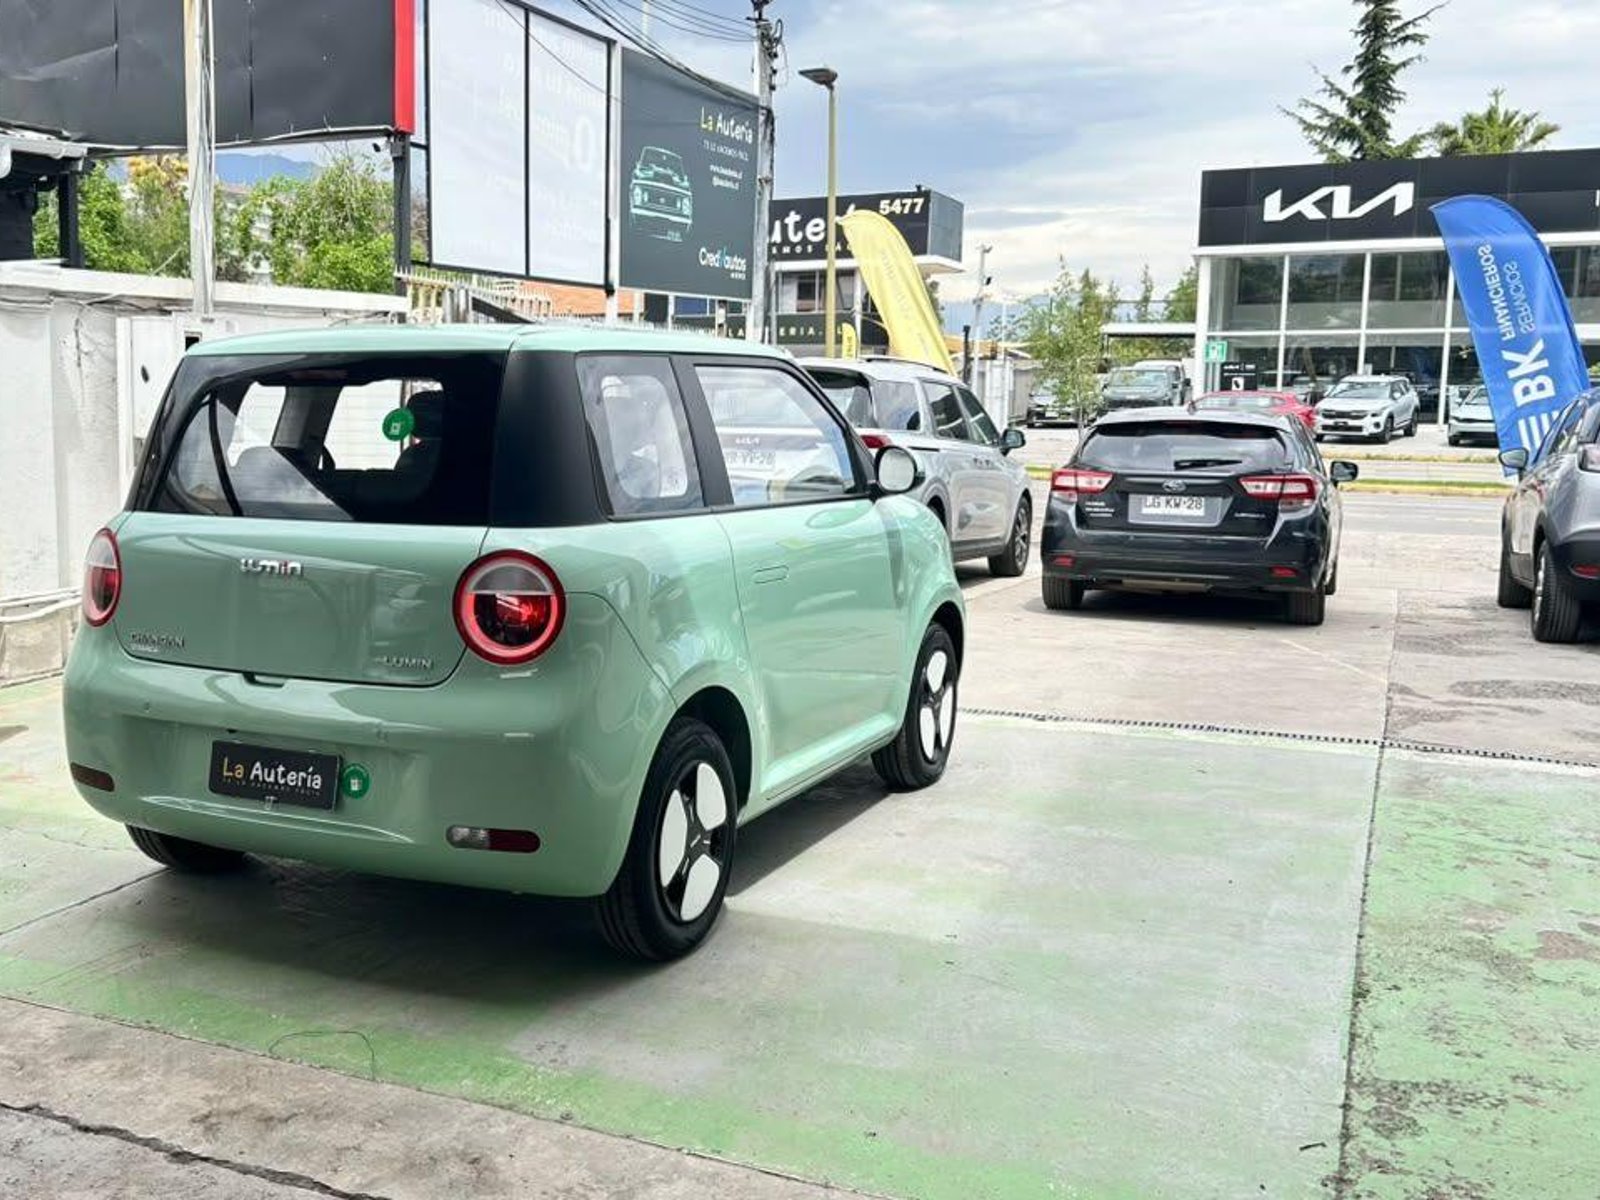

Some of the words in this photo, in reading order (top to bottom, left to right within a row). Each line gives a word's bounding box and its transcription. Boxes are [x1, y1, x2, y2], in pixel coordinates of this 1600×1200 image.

[878, 197, 925, 215] 5477
[1263, 181, 1415, 222] KIA
[222, 756, 244, 778] La
[250, 761, 322, 790] Autería
